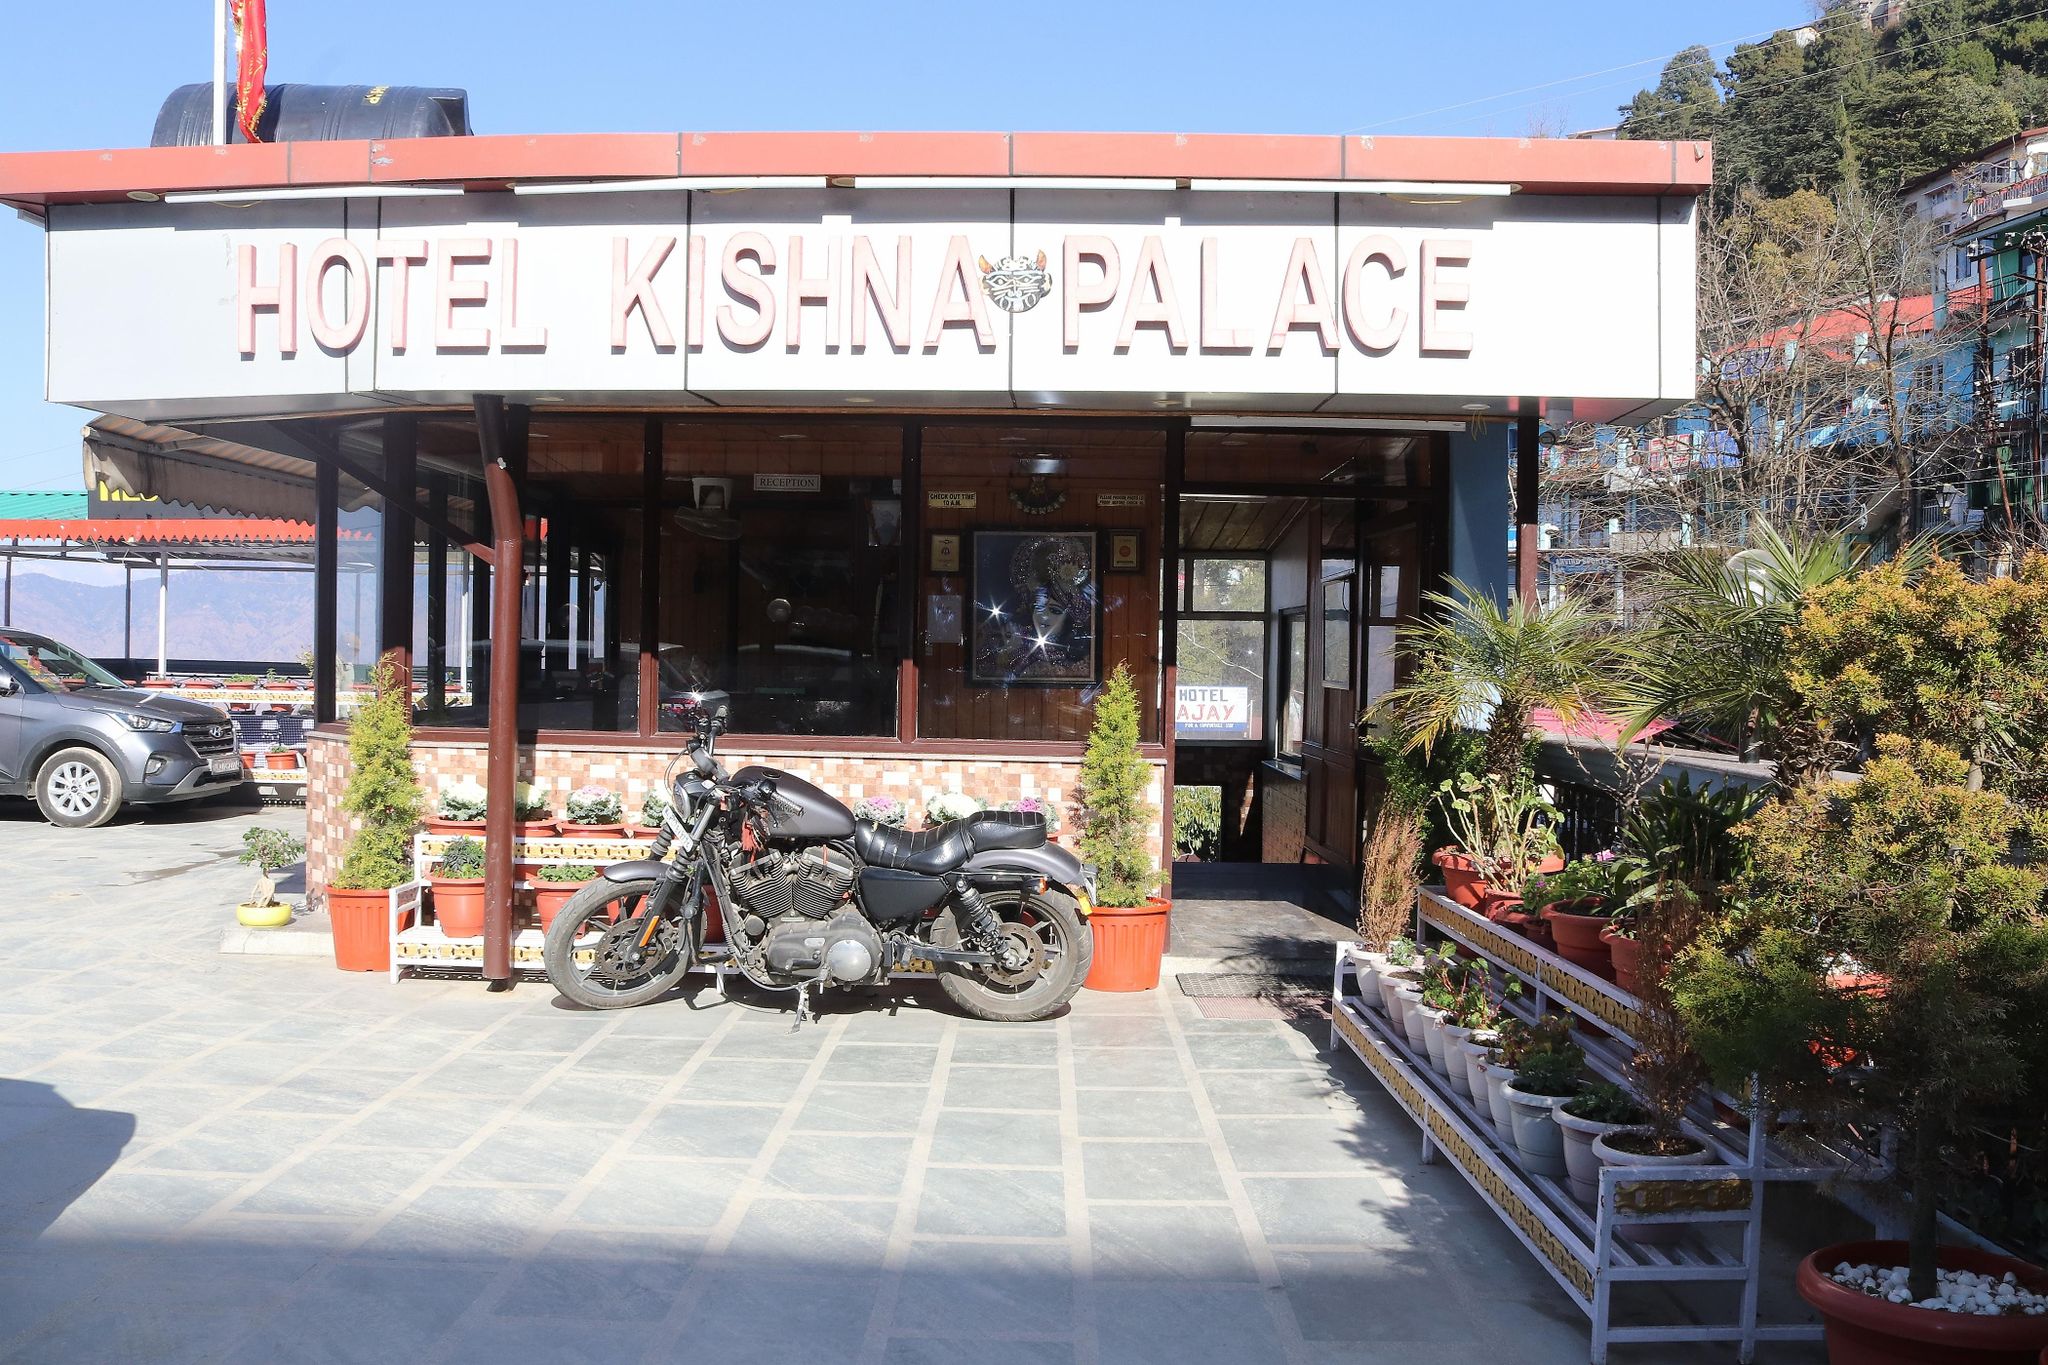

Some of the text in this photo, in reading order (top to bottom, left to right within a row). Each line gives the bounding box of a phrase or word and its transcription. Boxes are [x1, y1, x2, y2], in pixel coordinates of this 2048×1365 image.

[238, 234, 1473, 360] HOTEL KISHNA PALACE
[760, 478, 815, 487] RECEPTION
[1179, 689, 1228, 702] HOTEL
[1177, 704, 1235, 720] AJAY
